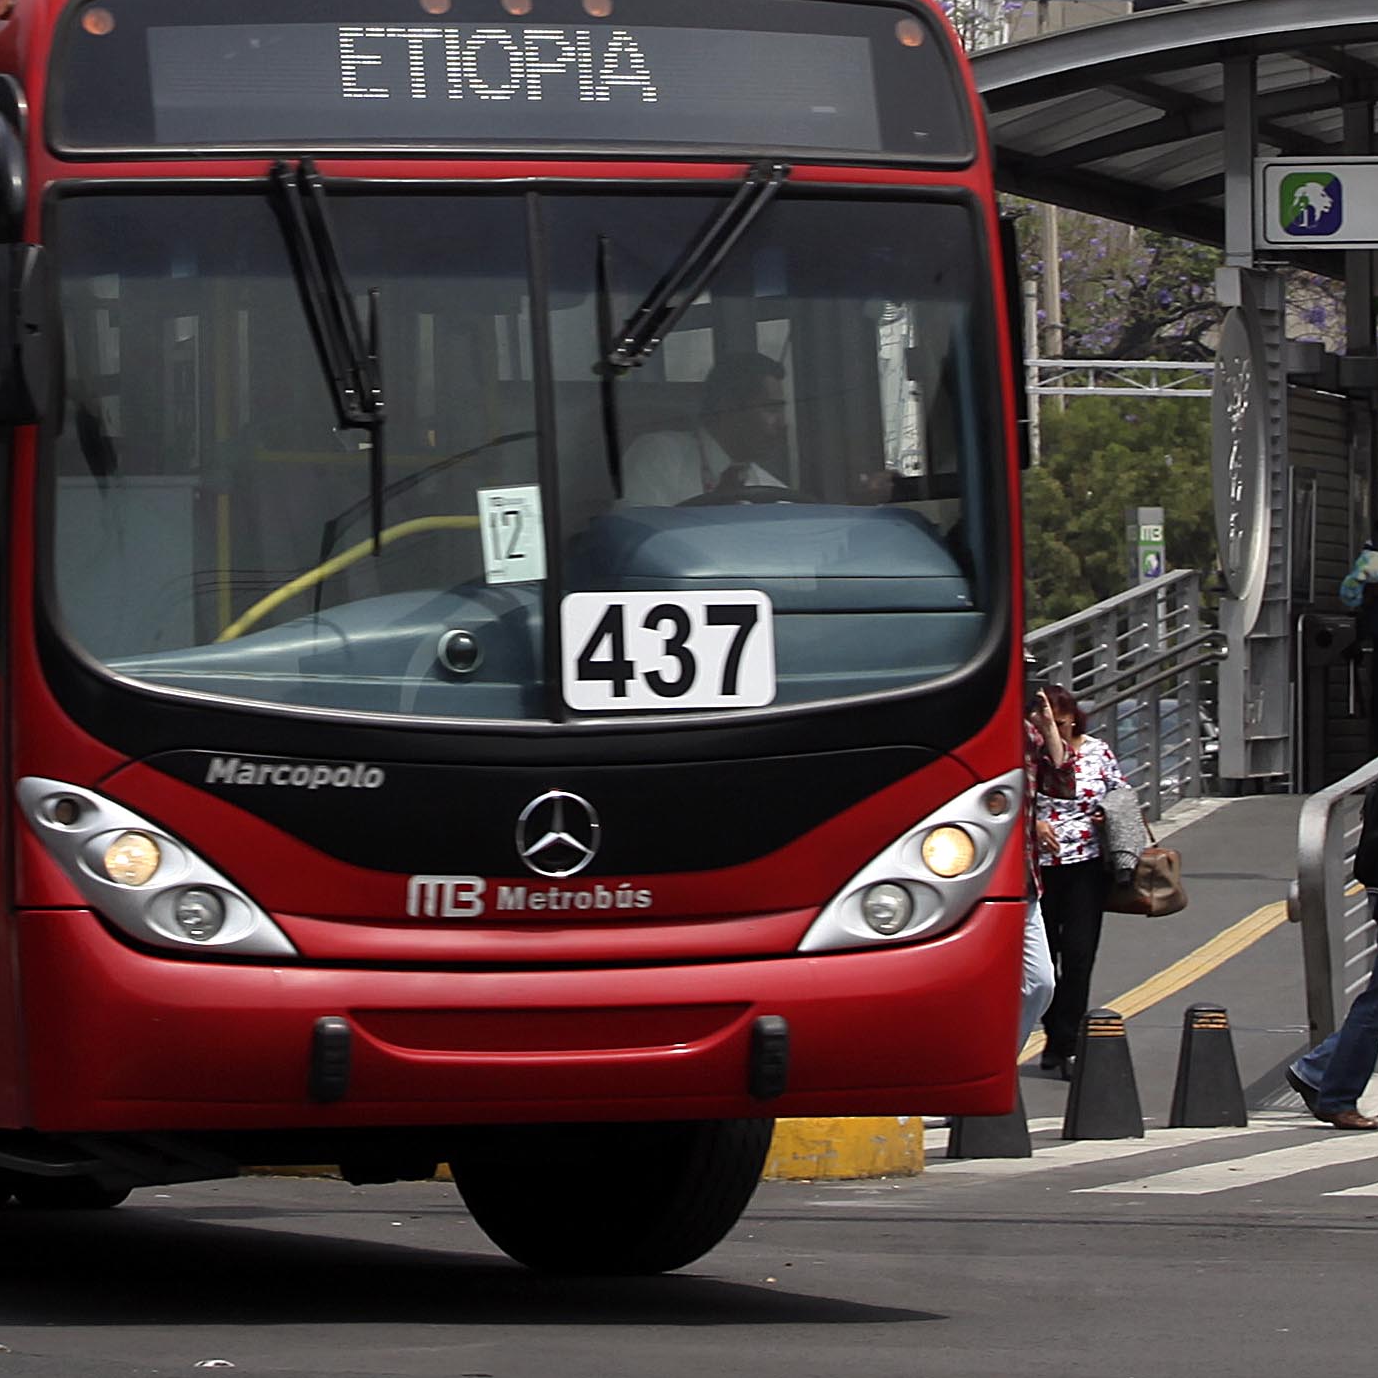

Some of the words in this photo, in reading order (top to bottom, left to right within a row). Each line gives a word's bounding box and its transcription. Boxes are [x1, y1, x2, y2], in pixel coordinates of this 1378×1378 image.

[338, 26, 658, 103] ETIOPIA
[574, 601, 761, 700] 437
[205, 756, 386, 790] Marcopolo
[406, 874, 488, 918] MB
[496, 882, 653, 911] Metrobús
